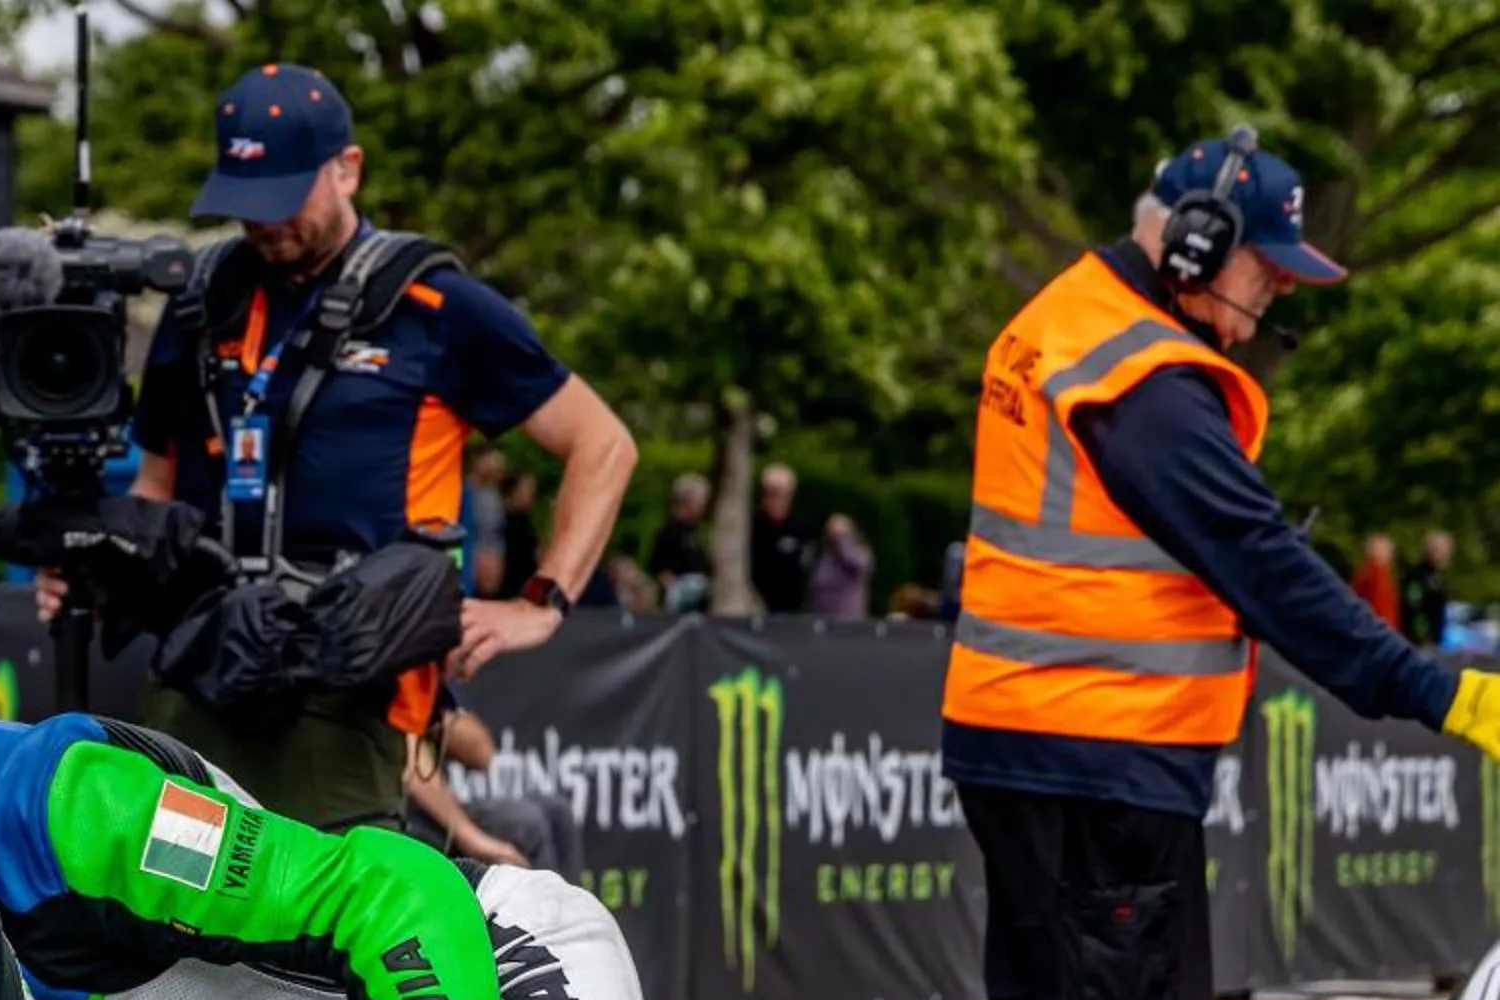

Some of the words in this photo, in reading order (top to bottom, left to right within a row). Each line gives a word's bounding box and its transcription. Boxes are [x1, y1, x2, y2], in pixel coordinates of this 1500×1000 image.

[786, 731, 968, 847] MONSTE
[1315, 740, 1460, 840] MONSTER
[224, 809, 264, 888] YAMAHA
[817, 861, 955, 903] ENERGY
